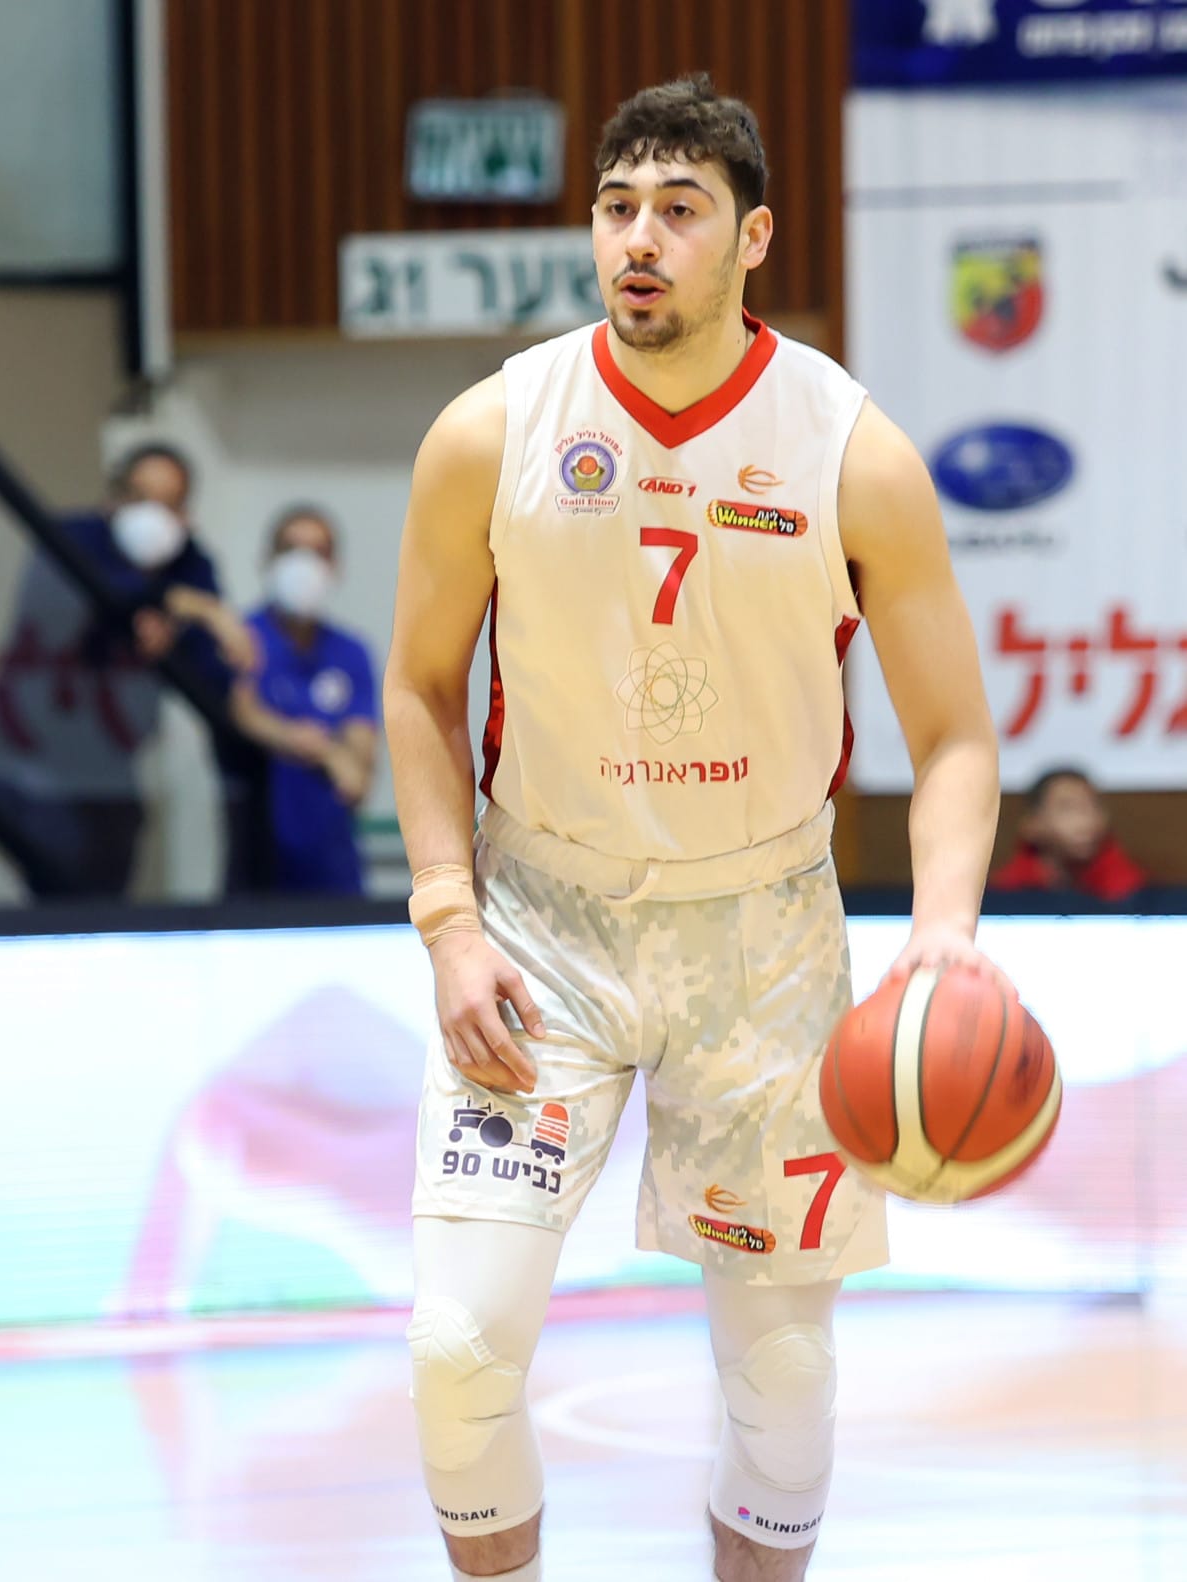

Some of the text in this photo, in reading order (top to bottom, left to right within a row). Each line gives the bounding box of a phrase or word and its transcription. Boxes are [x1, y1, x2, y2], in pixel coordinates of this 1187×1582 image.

[716, 505, 778, 531] Winner
[639, 527, 699, 625] 7
[442, 1150, 561, 1194] כביש 90
[783, 1152, 848, 1250] 7
